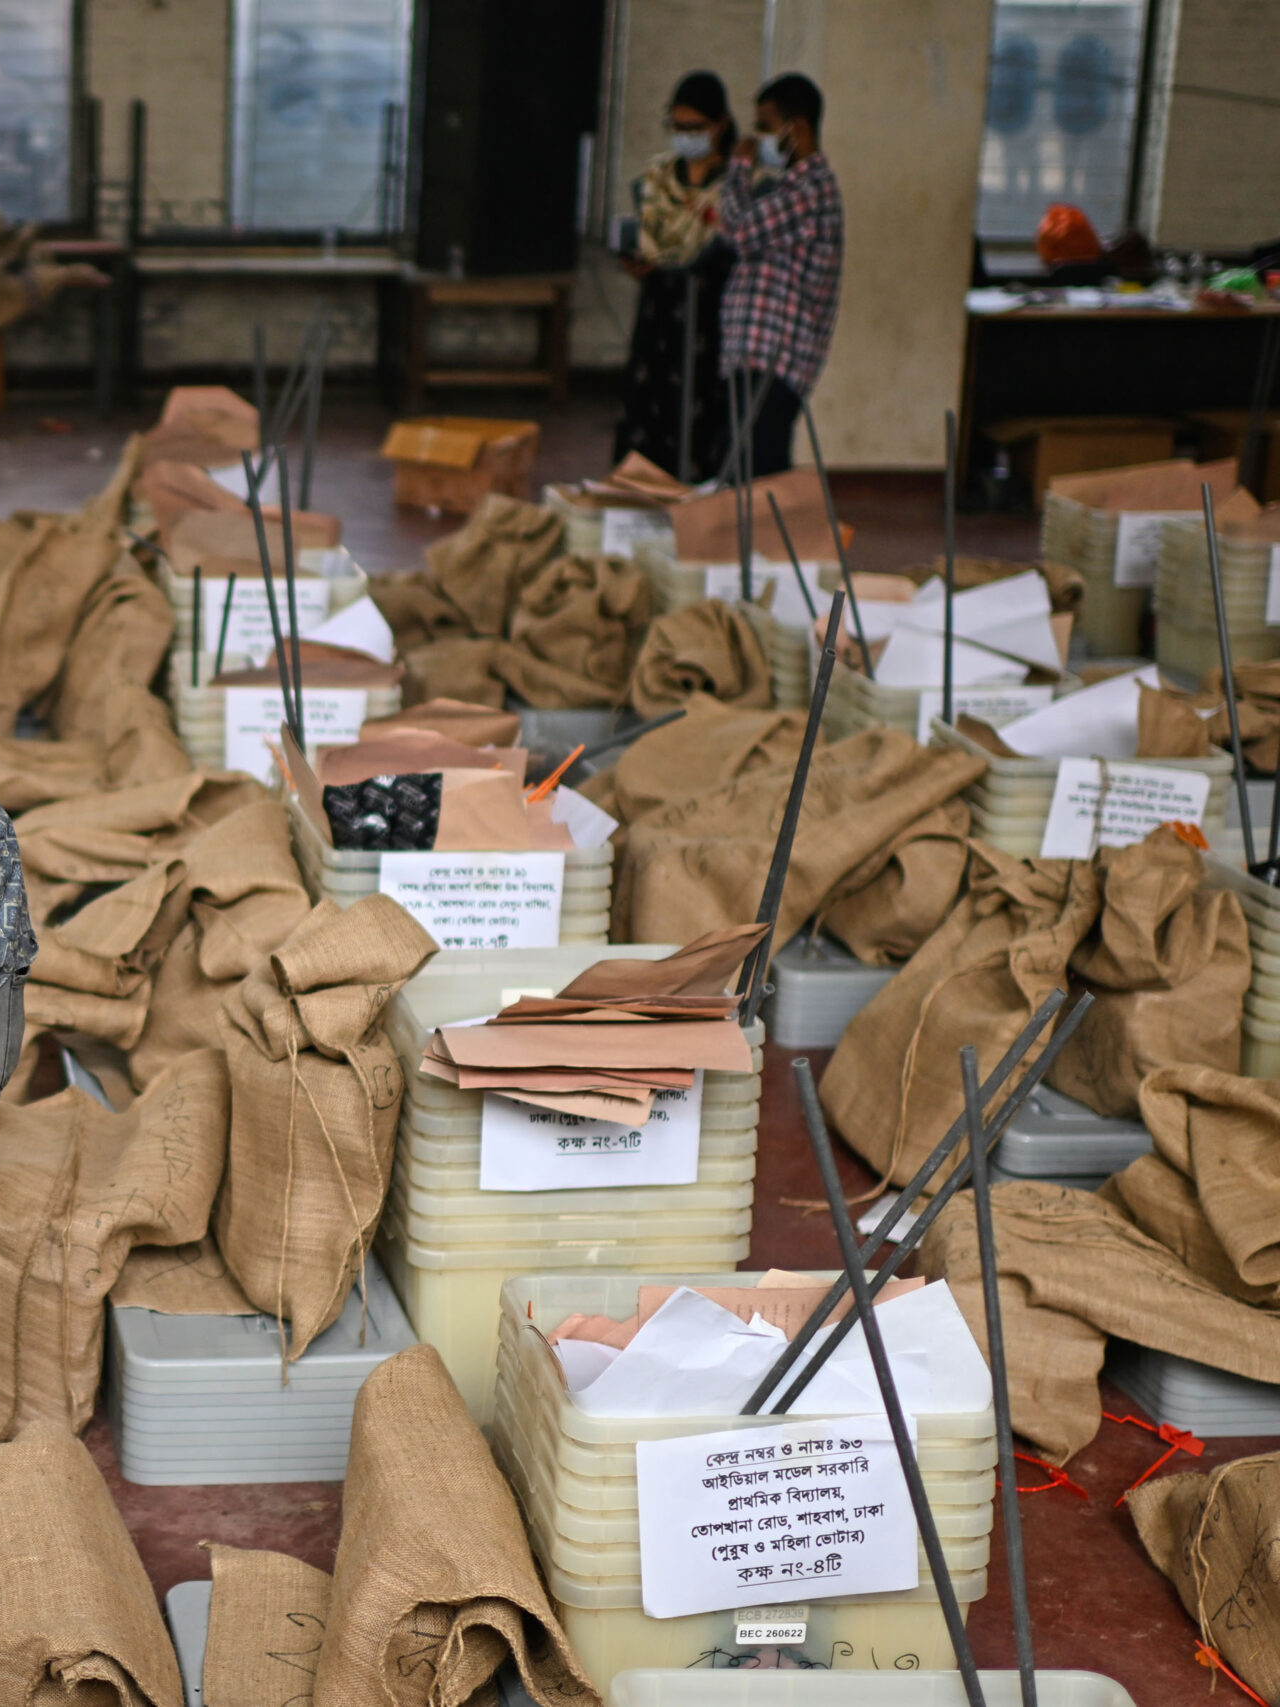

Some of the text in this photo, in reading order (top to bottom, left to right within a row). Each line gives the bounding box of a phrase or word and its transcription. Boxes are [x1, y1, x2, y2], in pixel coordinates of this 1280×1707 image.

[706, 1450, 740, 1467] কেন্দ্র
[744, 1445, 776, 1462] নম্বর
[781, 1443, 793, 1456] ও
[840, 1438, 863, 1450] ৯৩
[773, 1465, 813, 1481] মডেল
[817, 1456, 869, 1477] সরকারি
[728, 1491, 782, 1511] প্রাথমিক
[691, 1503, 885, 1538] তোপখানা রোড, শাহবাগ, ঢাকা
[754, 1541, 765, 1553] ও
[770, 1534, 811, 1552] মহিলা
[815, 1529, 865, 1548] ভোটার)
[736, 1565, 774, 1582] কক্ষ
[739, 1629, 804, 1638] BEC 260622
